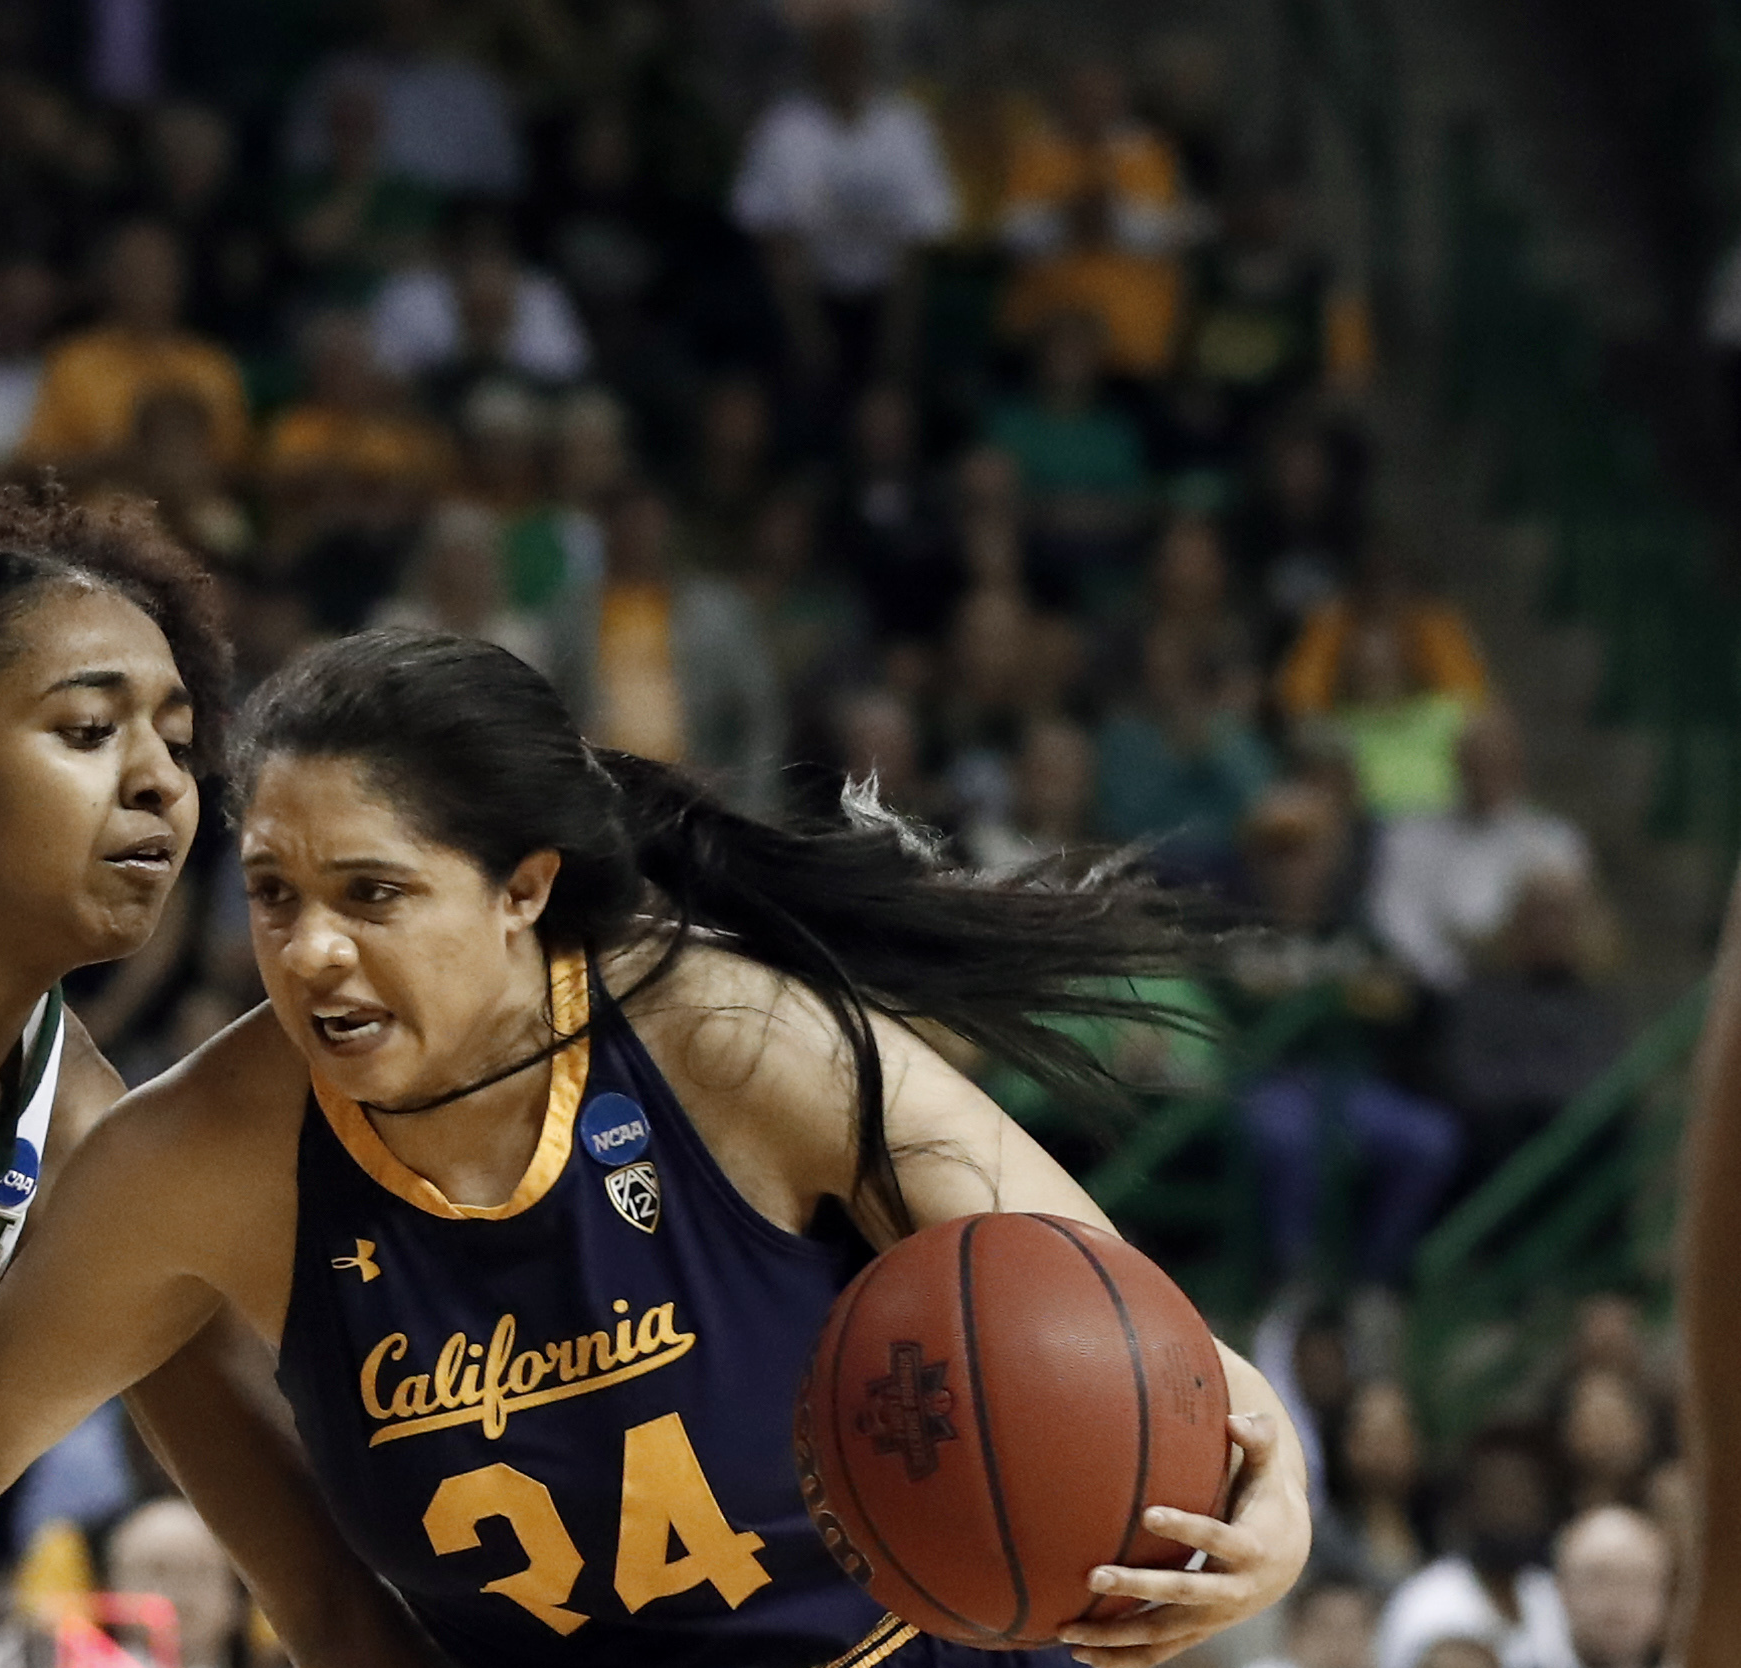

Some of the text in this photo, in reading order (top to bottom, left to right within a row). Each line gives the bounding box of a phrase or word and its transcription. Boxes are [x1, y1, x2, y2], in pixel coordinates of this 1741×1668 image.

[591, 1119, 646, 1154] NCAA
[628, 1191, 657, 1221] 12
[360, 1298, 697, 1448] California
[421, 1411, 773, 1637] 24
